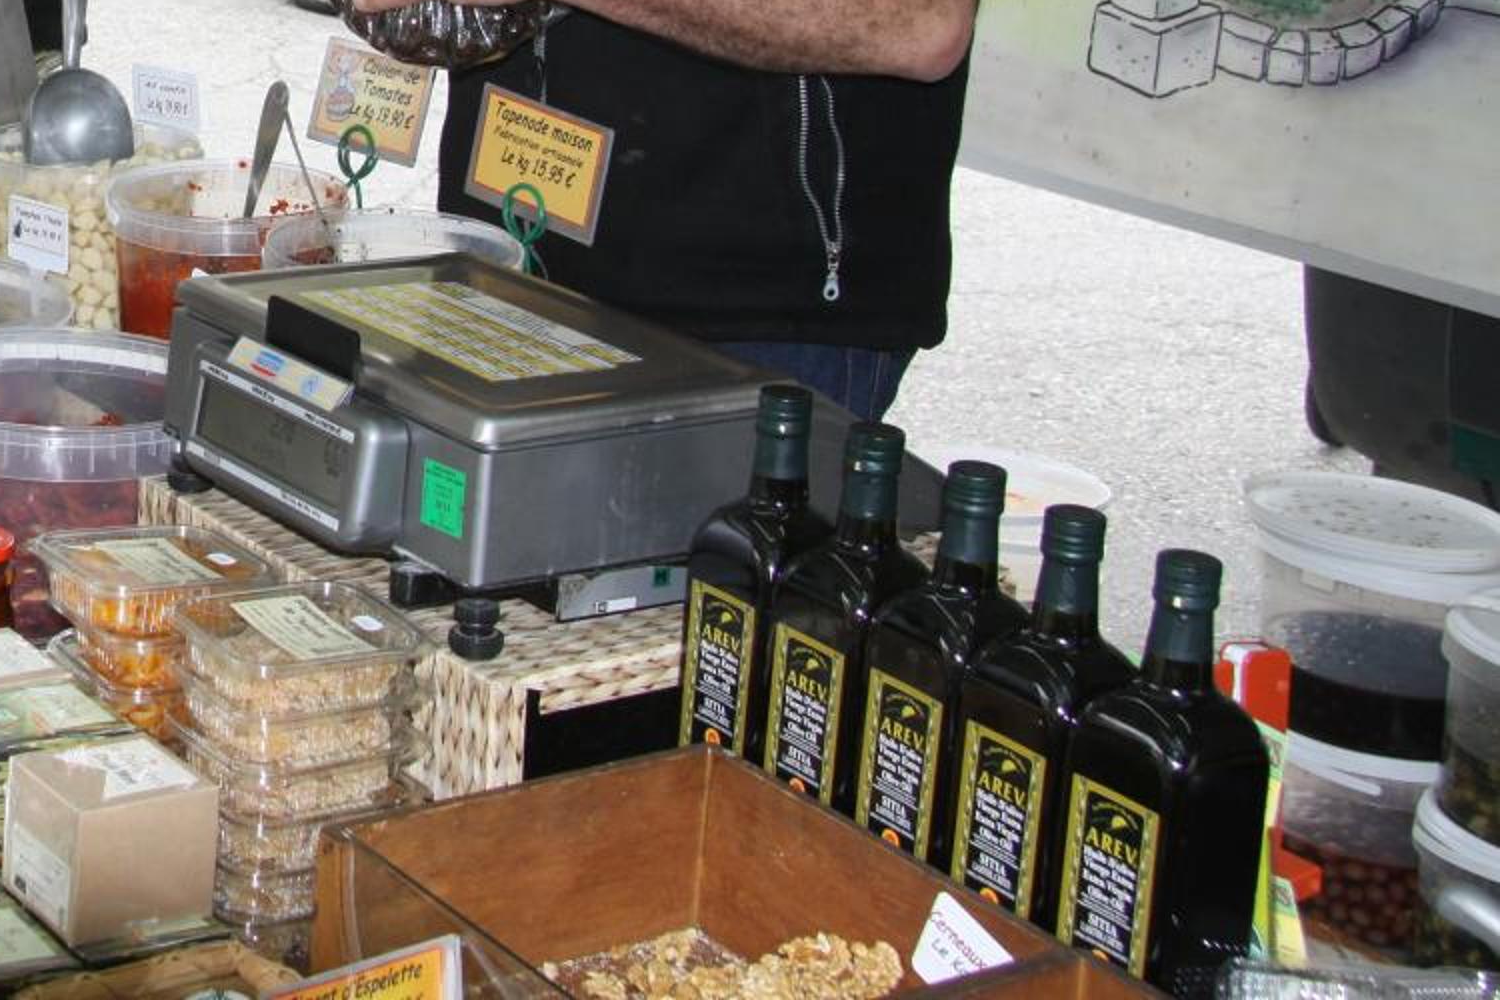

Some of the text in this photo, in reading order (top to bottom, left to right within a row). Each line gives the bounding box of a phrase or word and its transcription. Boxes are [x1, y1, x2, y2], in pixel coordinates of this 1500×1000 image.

[494, 101, 594, 153] Tapenade maison
[501, 147, 515, 165] Le
[702, 625, 739, 654] AREV
[787, 671, 826, 701] AREV
[881, 718, 923, 751] AREV
[978, 771, 1025, 809] AREV
[1085, 827, 1137, 867] AREV
